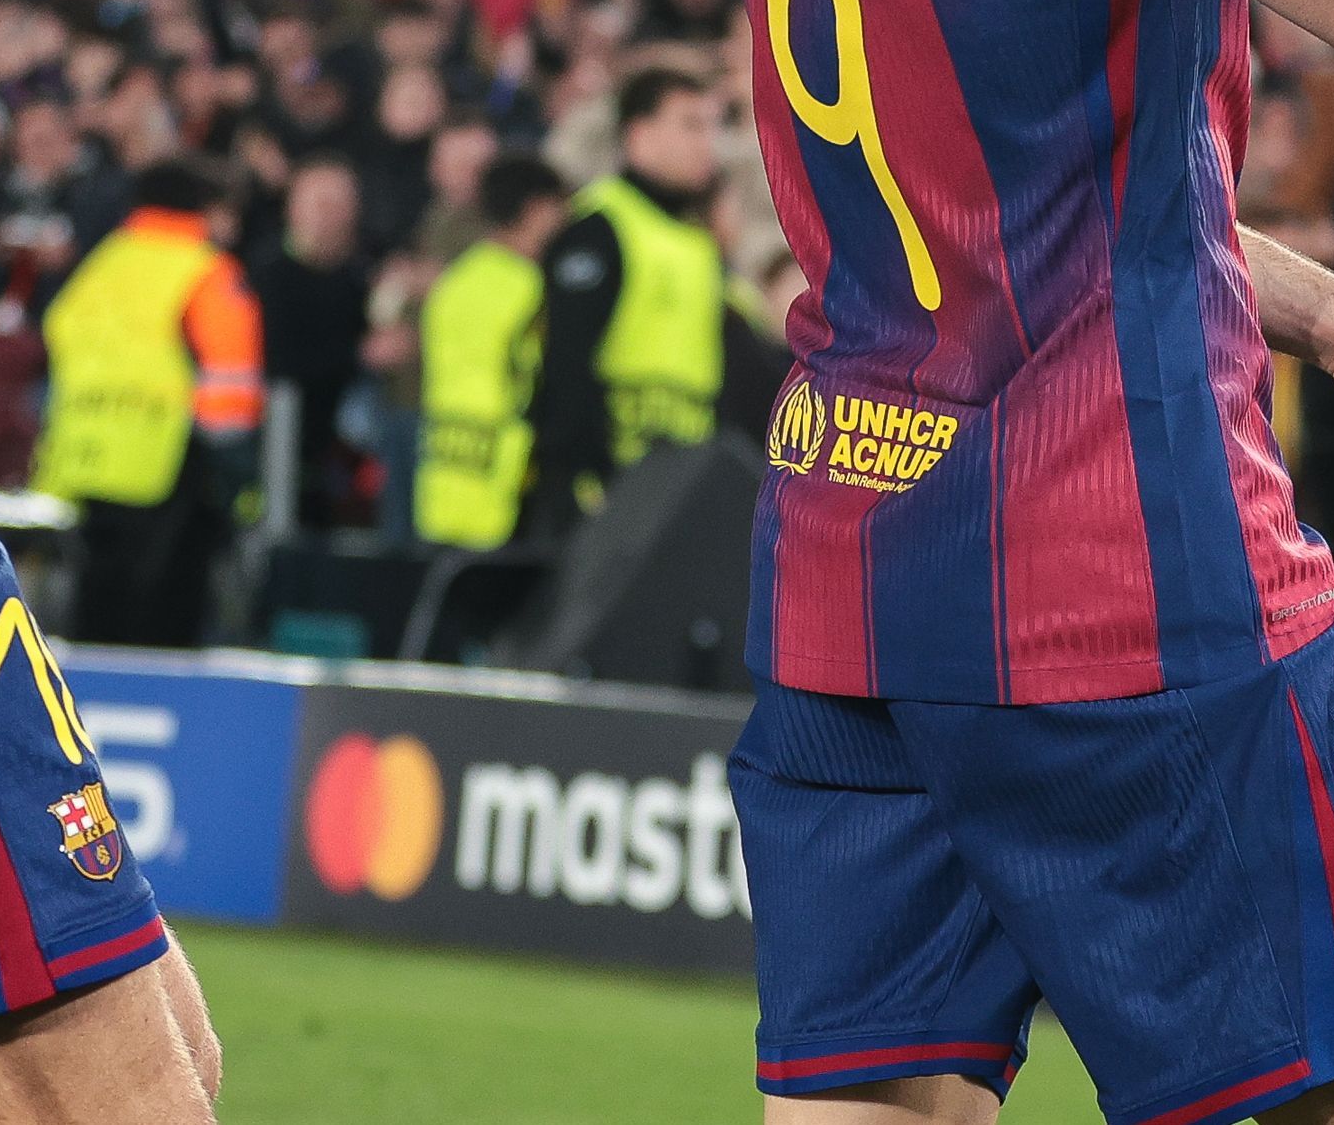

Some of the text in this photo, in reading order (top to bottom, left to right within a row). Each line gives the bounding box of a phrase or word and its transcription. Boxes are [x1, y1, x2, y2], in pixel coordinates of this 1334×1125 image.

[833, 394, 958, 451] UNHCR
[828, 468, 844, 482] The
[845, 473, 860, 487] UN
[860, 475, 896, 493] Refugee
[453, 751, 753, 922] mast
